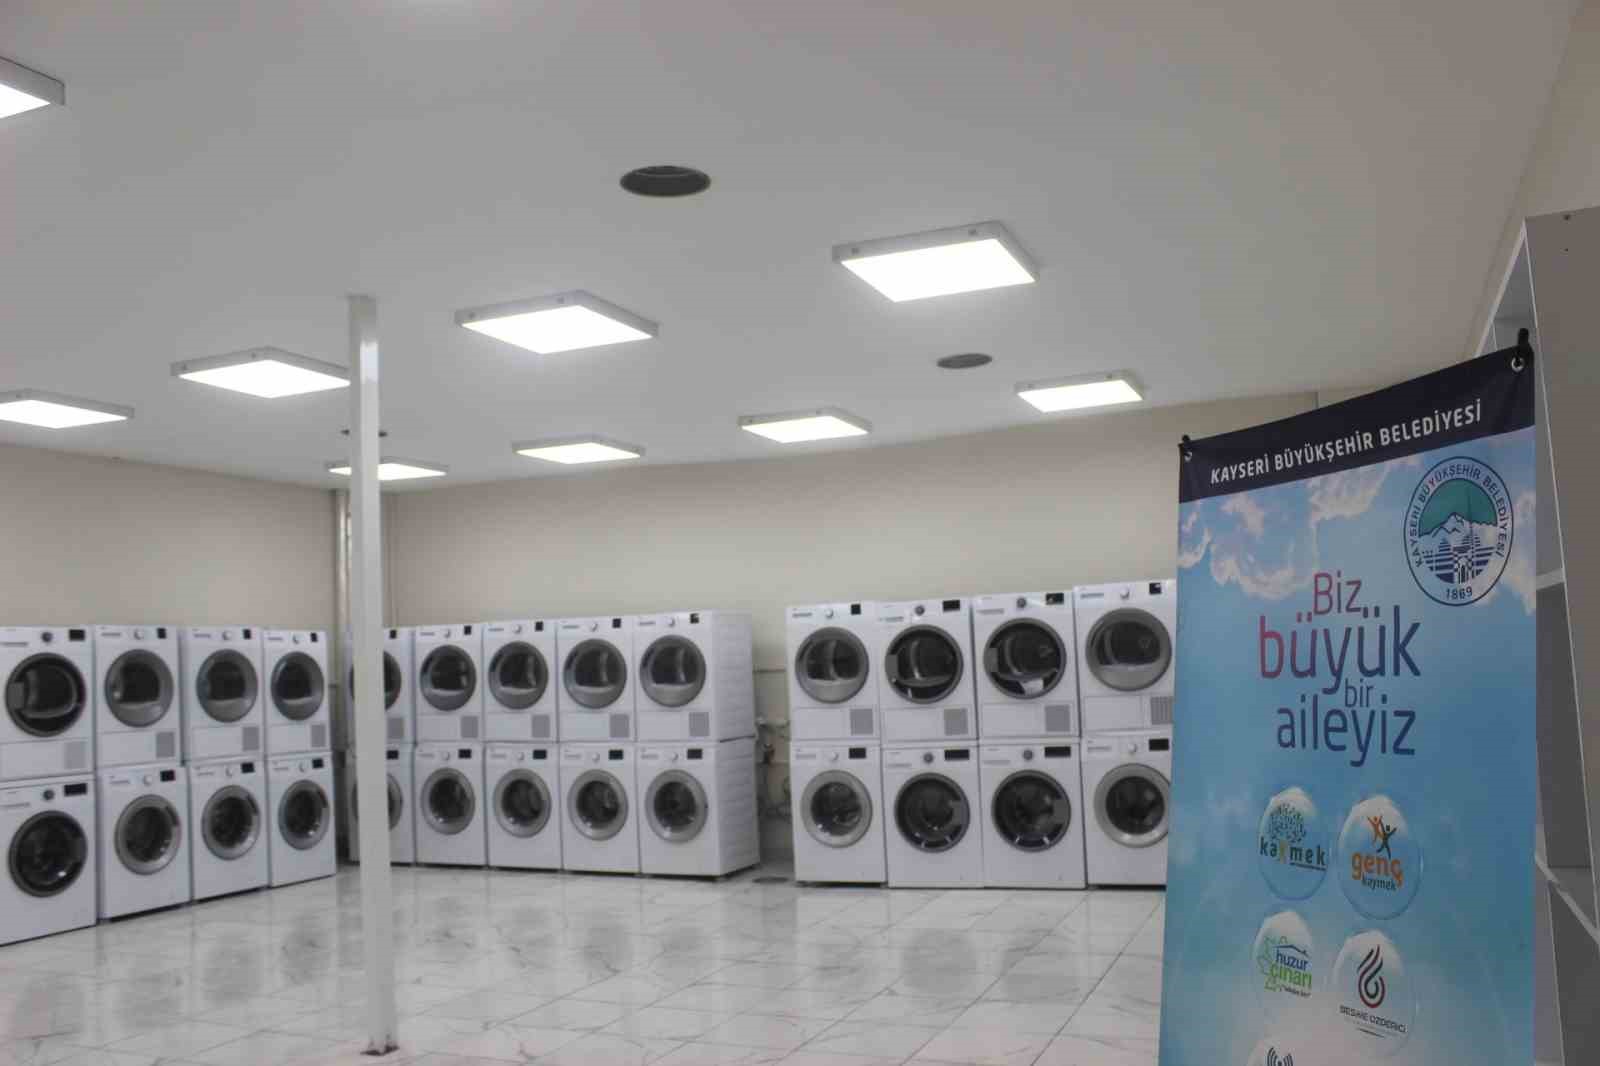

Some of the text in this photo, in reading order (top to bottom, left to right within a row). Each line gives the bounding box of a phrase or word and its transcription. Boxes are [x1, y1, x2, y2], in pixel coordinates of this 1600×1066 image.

[1210, 398, 1482, 484] KAYSERİ BÜYÜKŞEHİR BELEDİYESİ
[1313, 570, 1363, 616] Biz
[1445, 585, 1473, 600] 1869
[1259, 604, 1422, 695] büyük
[1344, 678, 1374, 708] bir
[1276, 693, 1417, 767] aileyiz
[1352, 851, 1404, 888] genç
[1276, 948, 1308, 971] huzur
